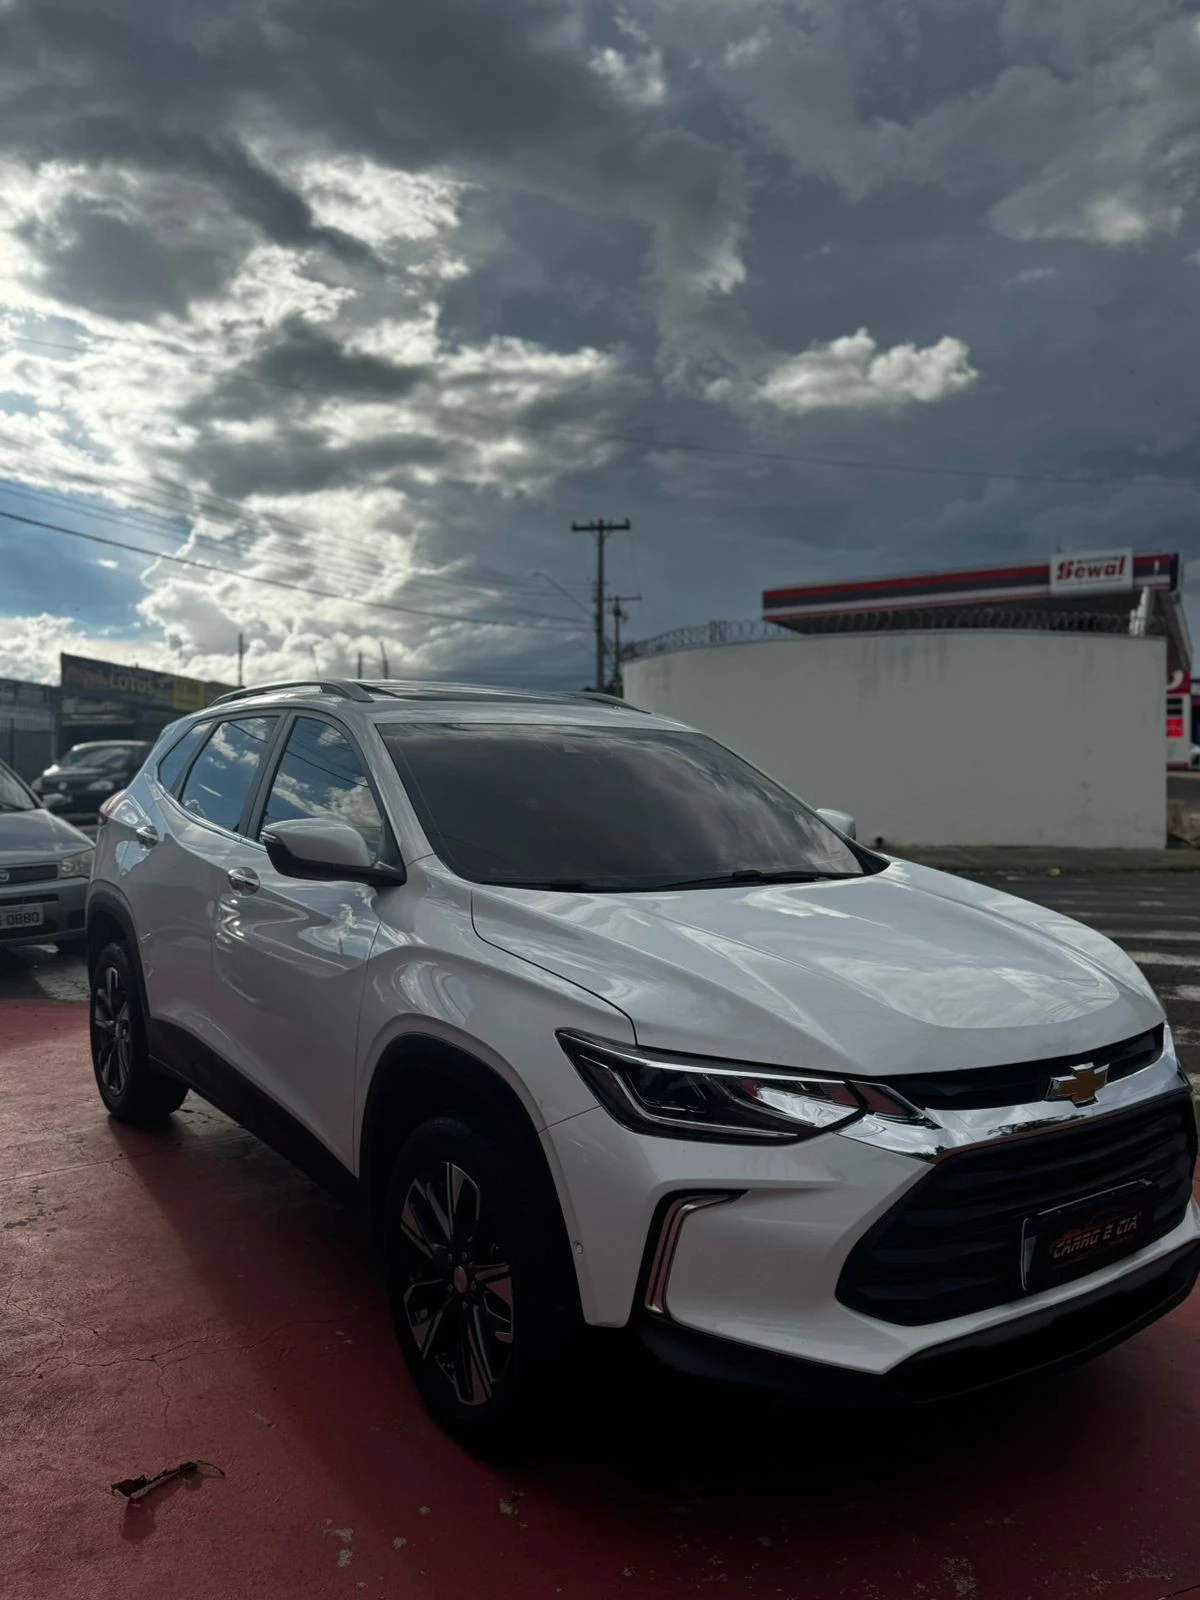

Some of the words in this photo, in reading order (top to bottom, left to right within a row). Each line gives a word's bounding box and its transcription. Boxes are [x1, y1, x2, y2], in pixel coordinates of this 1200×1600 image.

[1056, 555, 1126, 580] Sewal
[1052, 1229, 1102, 1258] CARRO
[1102, 1223, 1114, 1241] E
[1116, 1214, 1138, 1236] CIA
